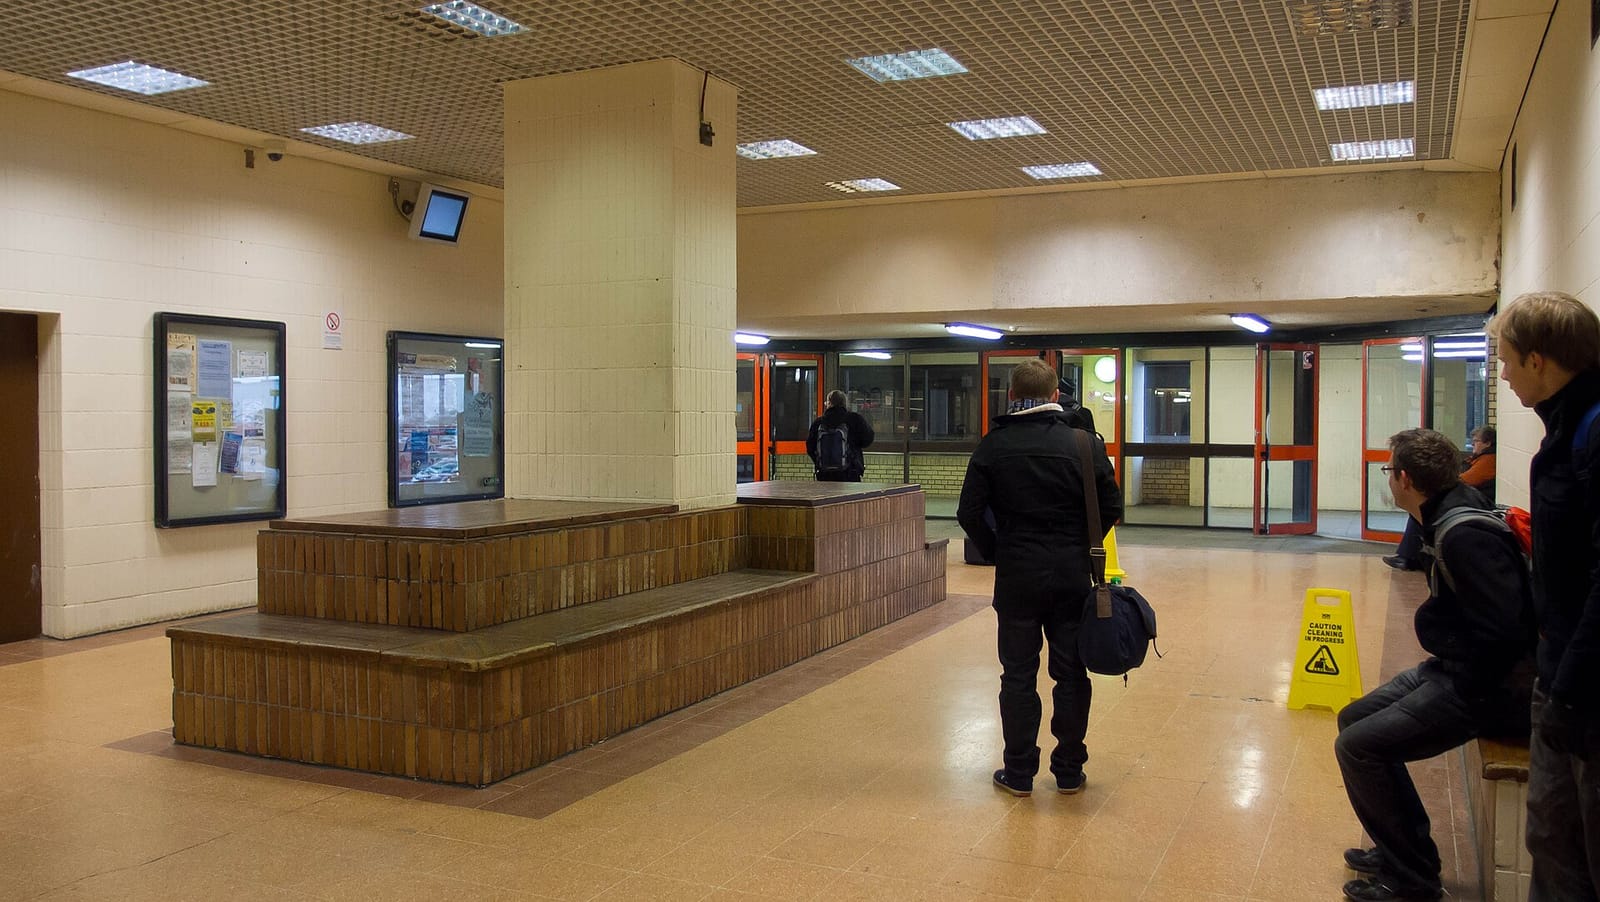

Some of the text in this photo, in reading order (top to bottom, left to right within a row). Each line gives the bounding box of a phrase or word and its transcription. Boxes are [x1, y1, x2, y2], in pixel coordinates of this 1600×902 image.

[1309, 622, 1342, 631] CAUTION
[1307, 629, 1343, 637] CLEANING
[1312, 636, 1344, 644] PROGRESS
